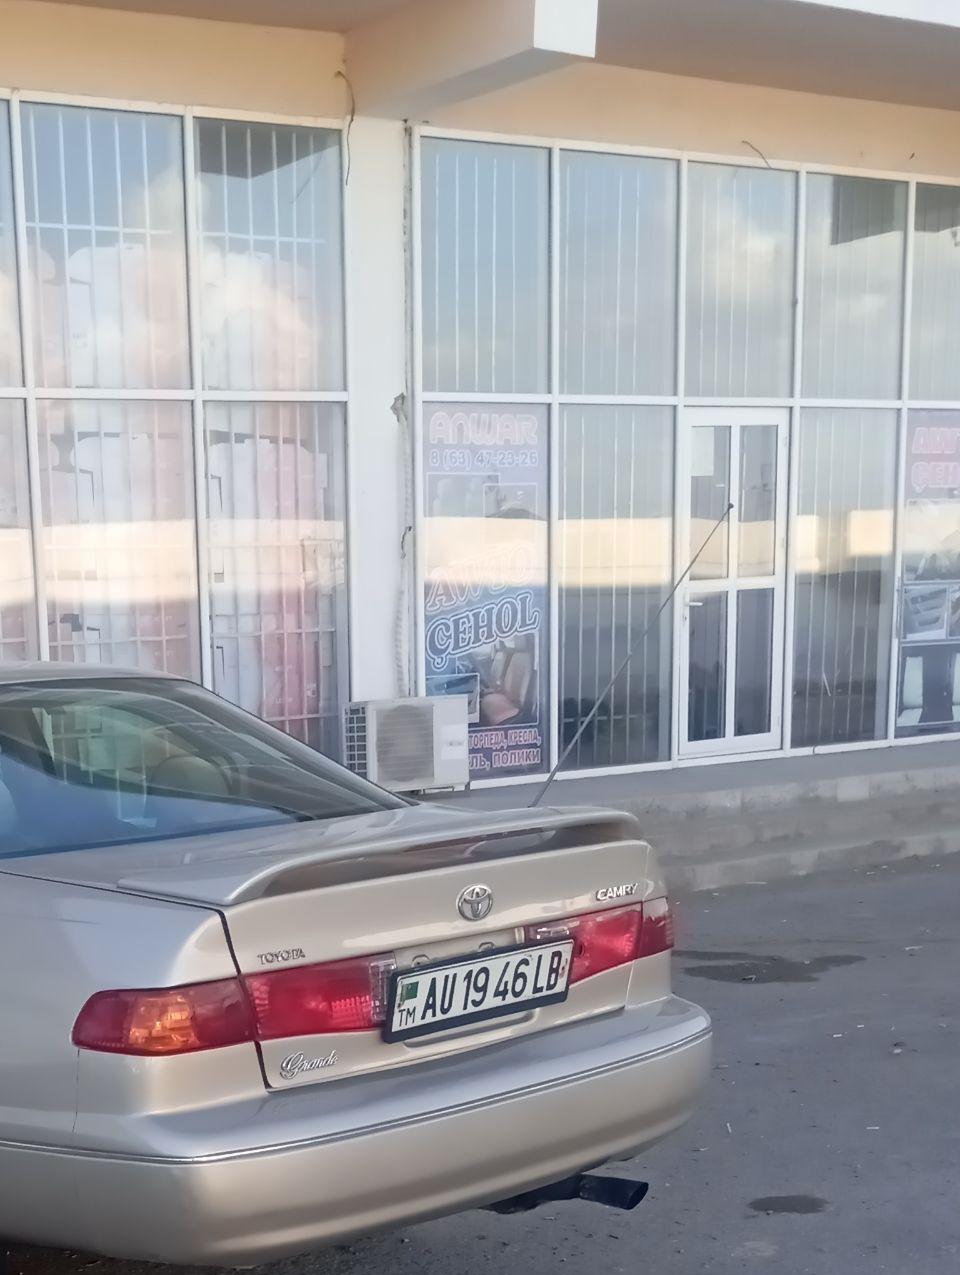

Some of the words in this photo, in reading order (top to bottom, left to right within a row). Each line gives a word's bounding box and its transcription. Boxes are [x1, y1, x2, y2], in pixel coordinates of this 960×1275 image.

[426, 590, 540, 671] ÇEHOL
[492, 748, 541, 767] ПОЛИКИ
[596, 882, 638, 901] CAMRY
[257, 948, 306, 965] TOYOTA
[398, 1006, 416, 1028] TM
[280, 1049, 338, 1080] Grande
